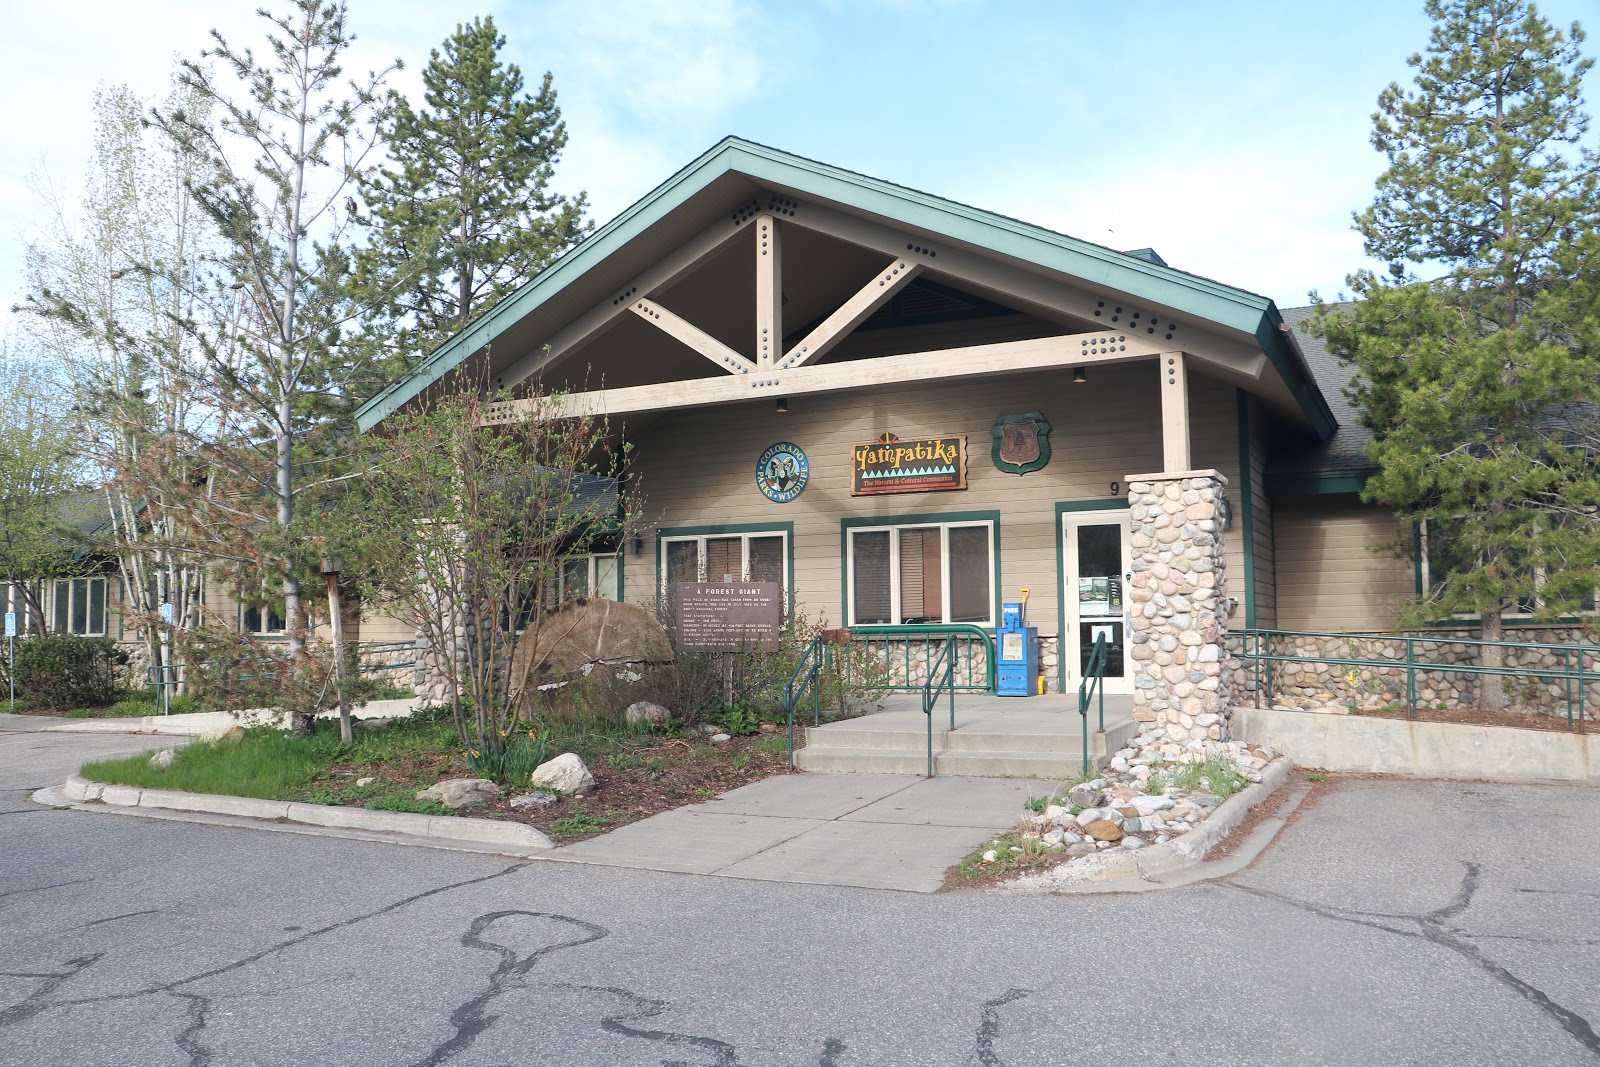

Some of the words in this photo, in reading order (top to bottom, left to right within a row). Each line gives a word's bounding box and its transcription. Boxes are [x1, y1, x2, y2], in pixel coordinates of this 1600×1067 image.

[760, 444, 804, 465] COLORADO
[757, 471, 774, 498] PARKS
[778, 466, 808, 501] WILDLIFE
[874, 478, 894, 486] Natural
[900, 477, 922, 485] Cultural
[922, 475, 953, 483] Connection
